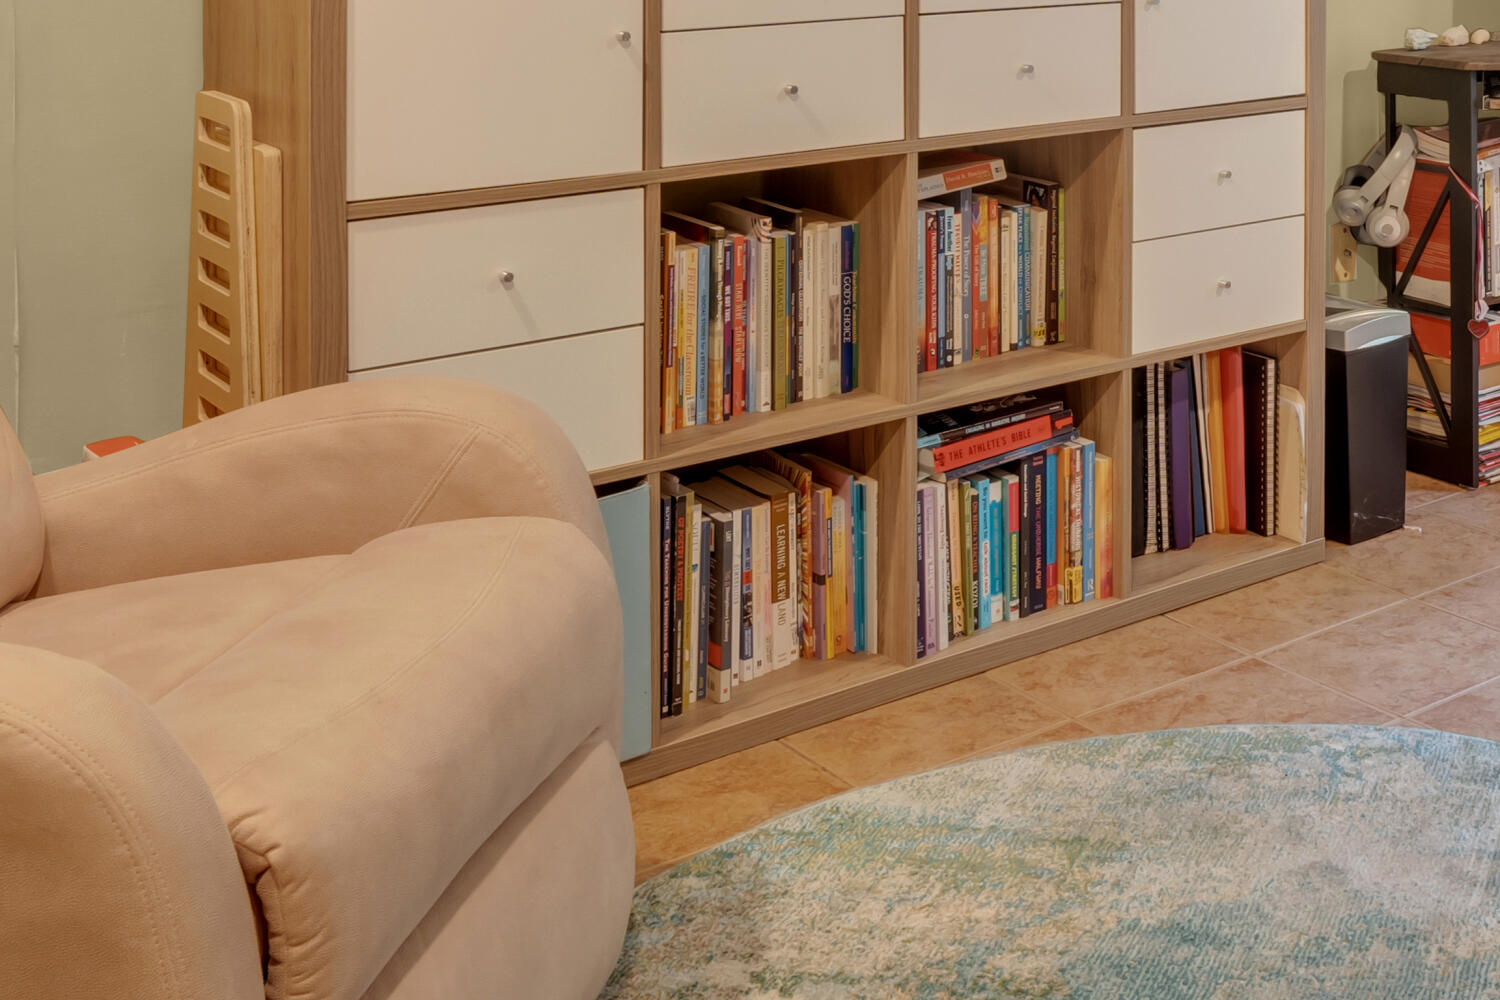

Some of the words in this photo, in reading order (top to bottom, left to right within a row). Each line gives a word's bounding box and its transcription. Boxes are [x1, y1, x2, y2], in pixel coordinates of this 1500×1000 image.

[686, 266, 696, 311] FREIRE
[843, 276, 851, 305] GOD'S
[686, 312, 696, 325] for
[843, 306, 851, 343] CHOICE
[686, 328, 695, 344] the
[685, 344, 695, 396] Classroom
[948, 450, 966, 461] THE
[968, 435, 1007, 457] ATHLETE'S
[1011, 429, 1031, 442] BIBLE
[776, 523, 785, 569] LEARNING
[776, 579, 785, 599] NEW
[777, 604, 785, 626] LAND
